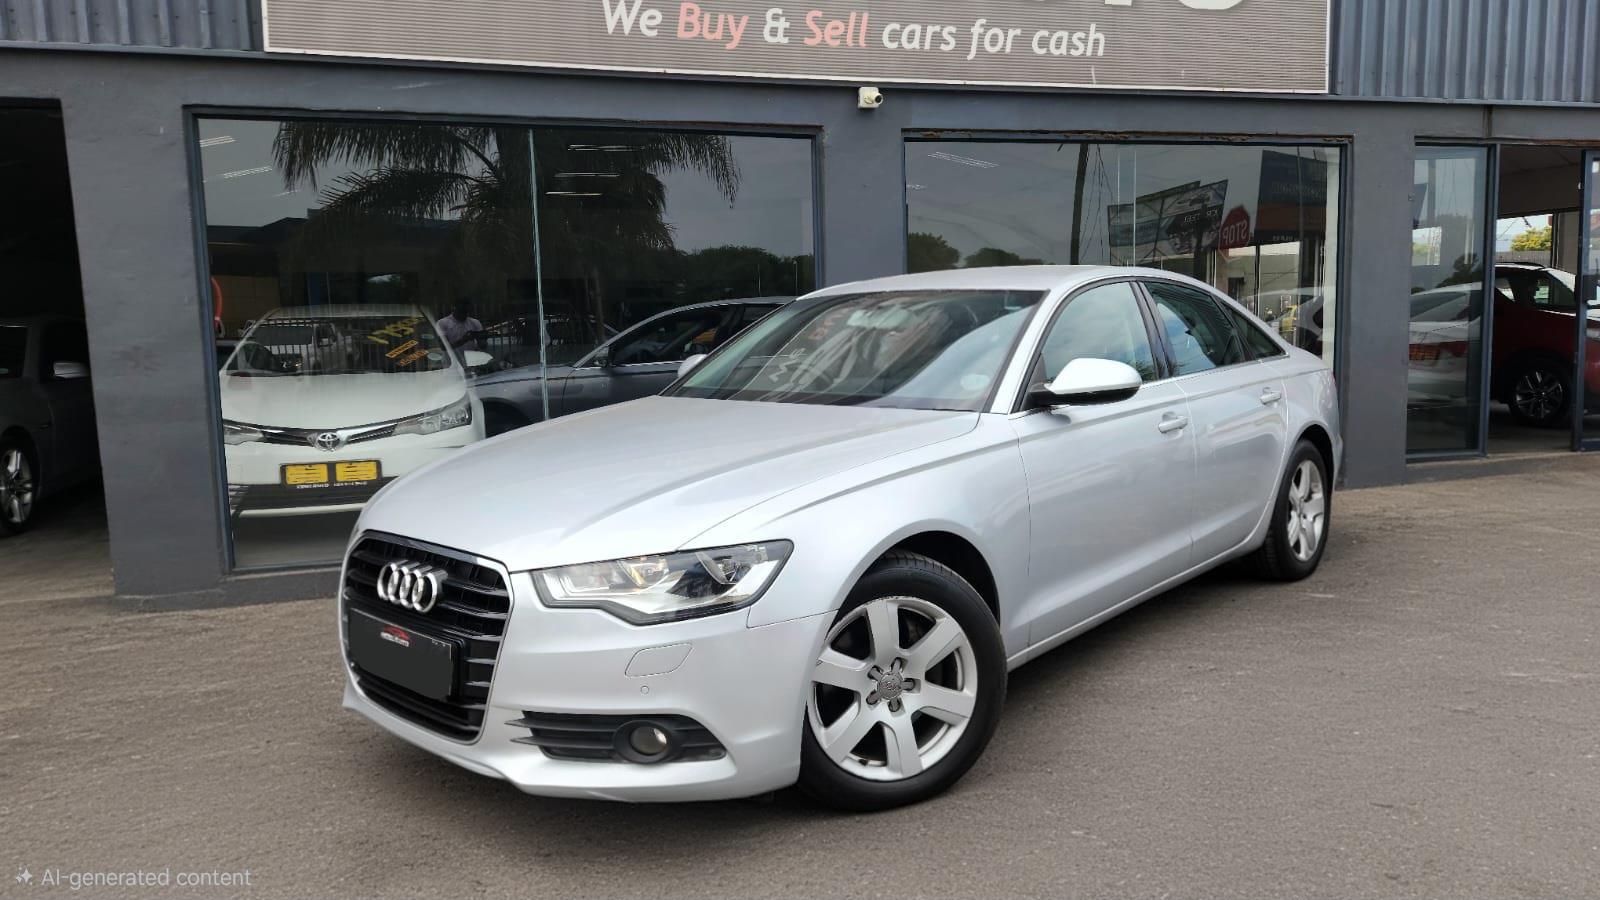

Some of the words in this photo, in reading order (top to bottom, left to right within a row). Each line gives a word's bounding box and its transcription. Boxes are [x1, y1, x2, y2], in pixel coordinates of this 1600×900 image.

[602, 0, 663, 37] We
[677, 2, 749, 49] Buy
[763, 8, 790, 44] &
[804, 10, 869, 47] Sell
[882, 22, 957, 50] cars
[967, 19, 1022, 61] for
[1031, 23, 1106, 57] cash
